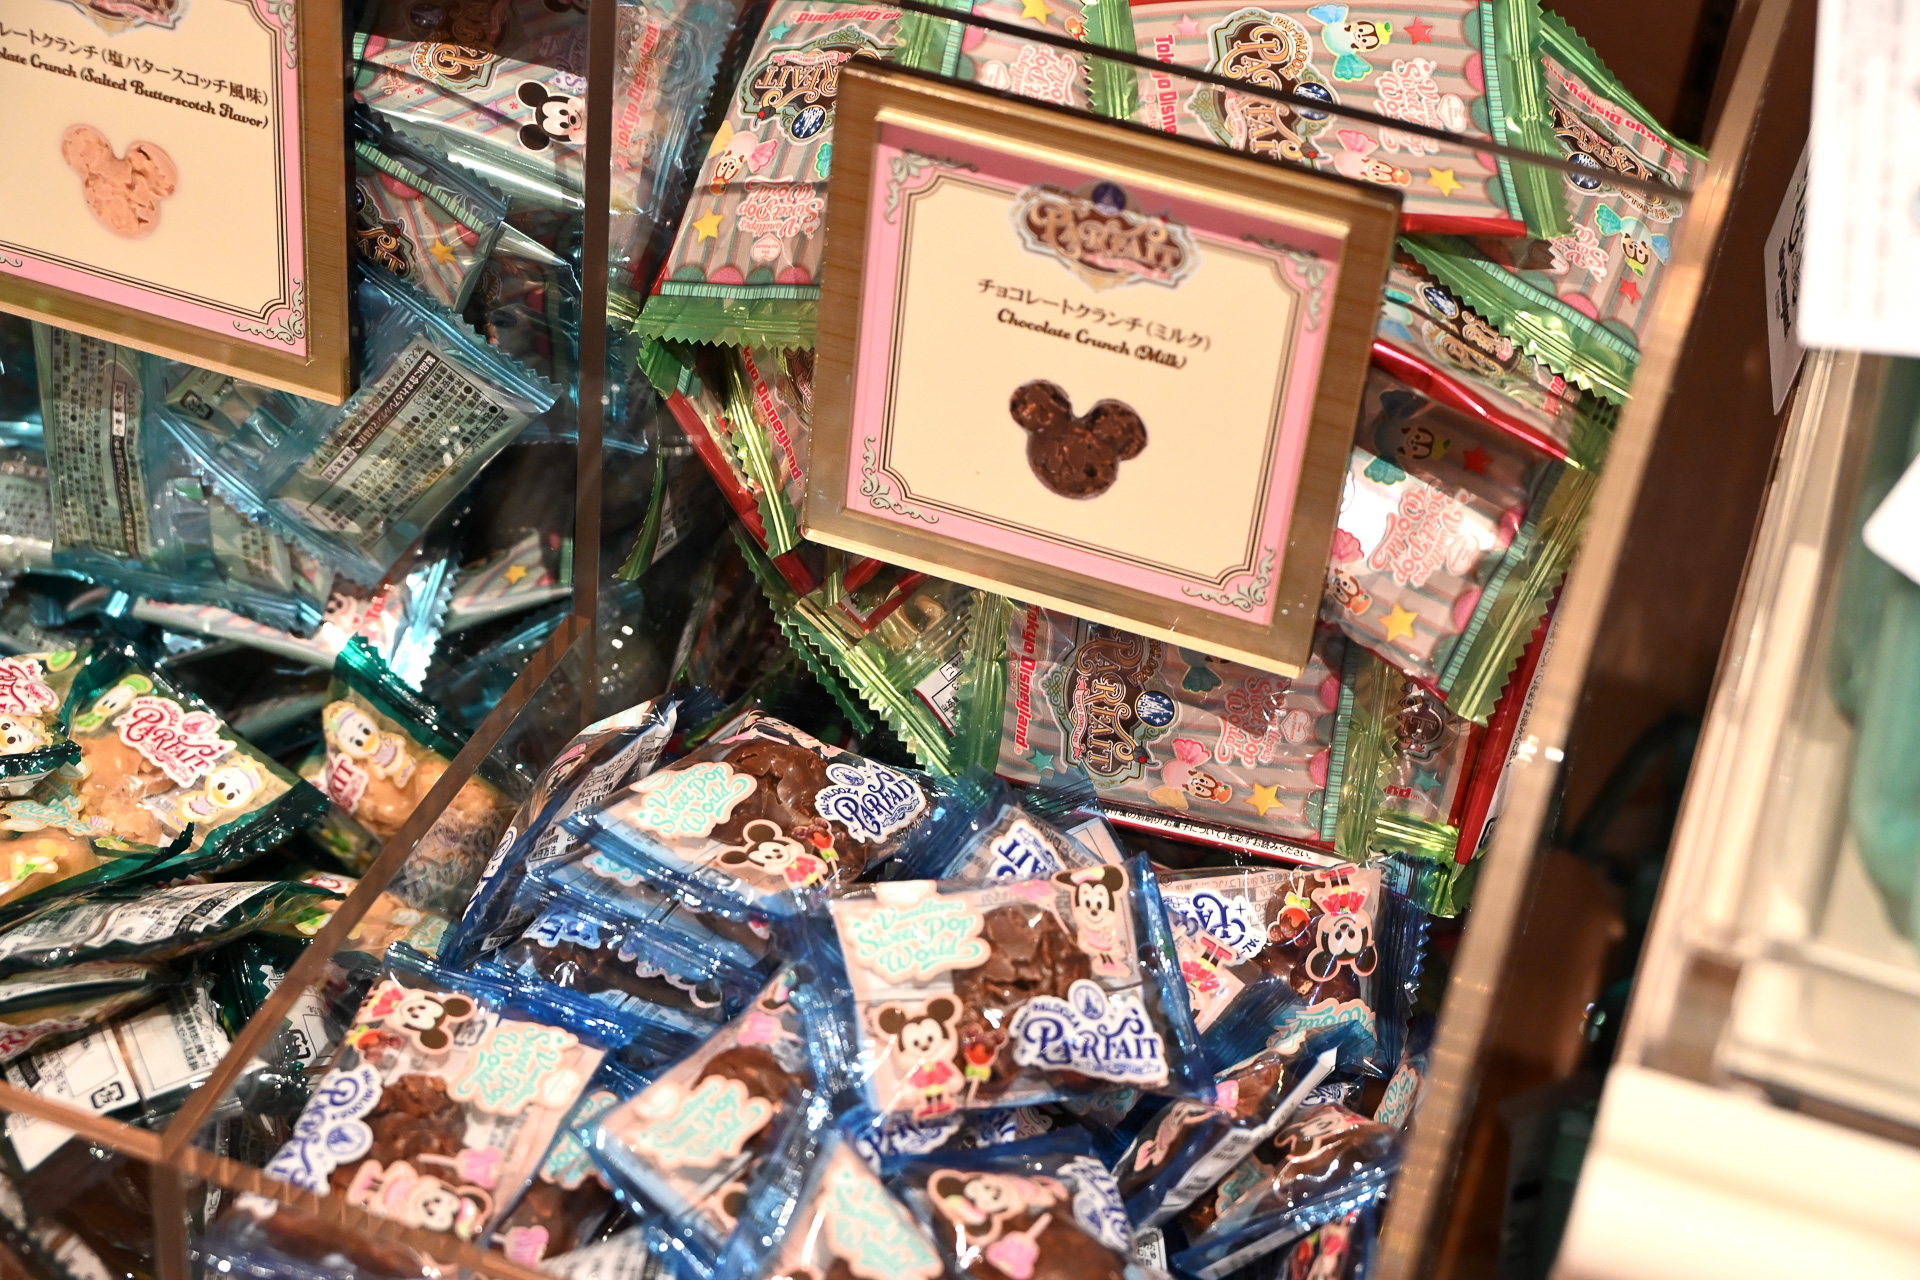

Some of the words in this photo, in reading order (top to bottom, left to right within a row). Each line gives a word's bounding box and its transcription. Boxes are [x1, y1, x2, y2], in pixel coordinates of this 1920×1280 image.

[796, 10, 881, 23] Disneyland
[1273, 15, 1308, 79] PAL-PALOOZA
[30, 54, 78, 79] Crunch
[80, 66, 128, 92] (Salted
[130, 79, 216, 116] Butterscotch
[219, 103, 269, 129] Flavor)
[1395, 61, 1424, 113] Sweet
[739, 197, 778, 219] Pop
[745, 180, 815, 204] World
[773, 198, 823, 223] Sweet
[997, 308, 1072, 341] Chocolate
[1075, 329, 1130, 356] Crunch
[1134, 344, 1188, 370] (Milk)
[743, 345, 760, 382] kyo
[756, 380, 803, 480] Disneyland
[1371, 489, 1425, 569] World
[1420, 481, 1453, 541] Sweet
[1393, 531, 1429, 583] Pop
[1022, 604, 1040, 654] Tokyo
[1015, 655, 1037, 749] Disneyland
[1076, 629, 1137, 772] PARFAIT
[1217, 688, 1248, 762] World
[1246, 678, 1272, 726] Sweet
[127, 706, 223, 773] PARFAIT
[1237, 722, 1264, 766] Pop
[650, 788, 694, 833] Sweet
[687, 765, 726, 801] Pop
[681, 778, 748, 832] World
[820, 787, 859, 816] PAL-PALOOZA
[834, 771, 916, 836] PARFAIT
[879, 937, 981, 973] World
[923, 916, 975, 945] Pop
[1024, 1016, 1158, 1066] PARFAIT
